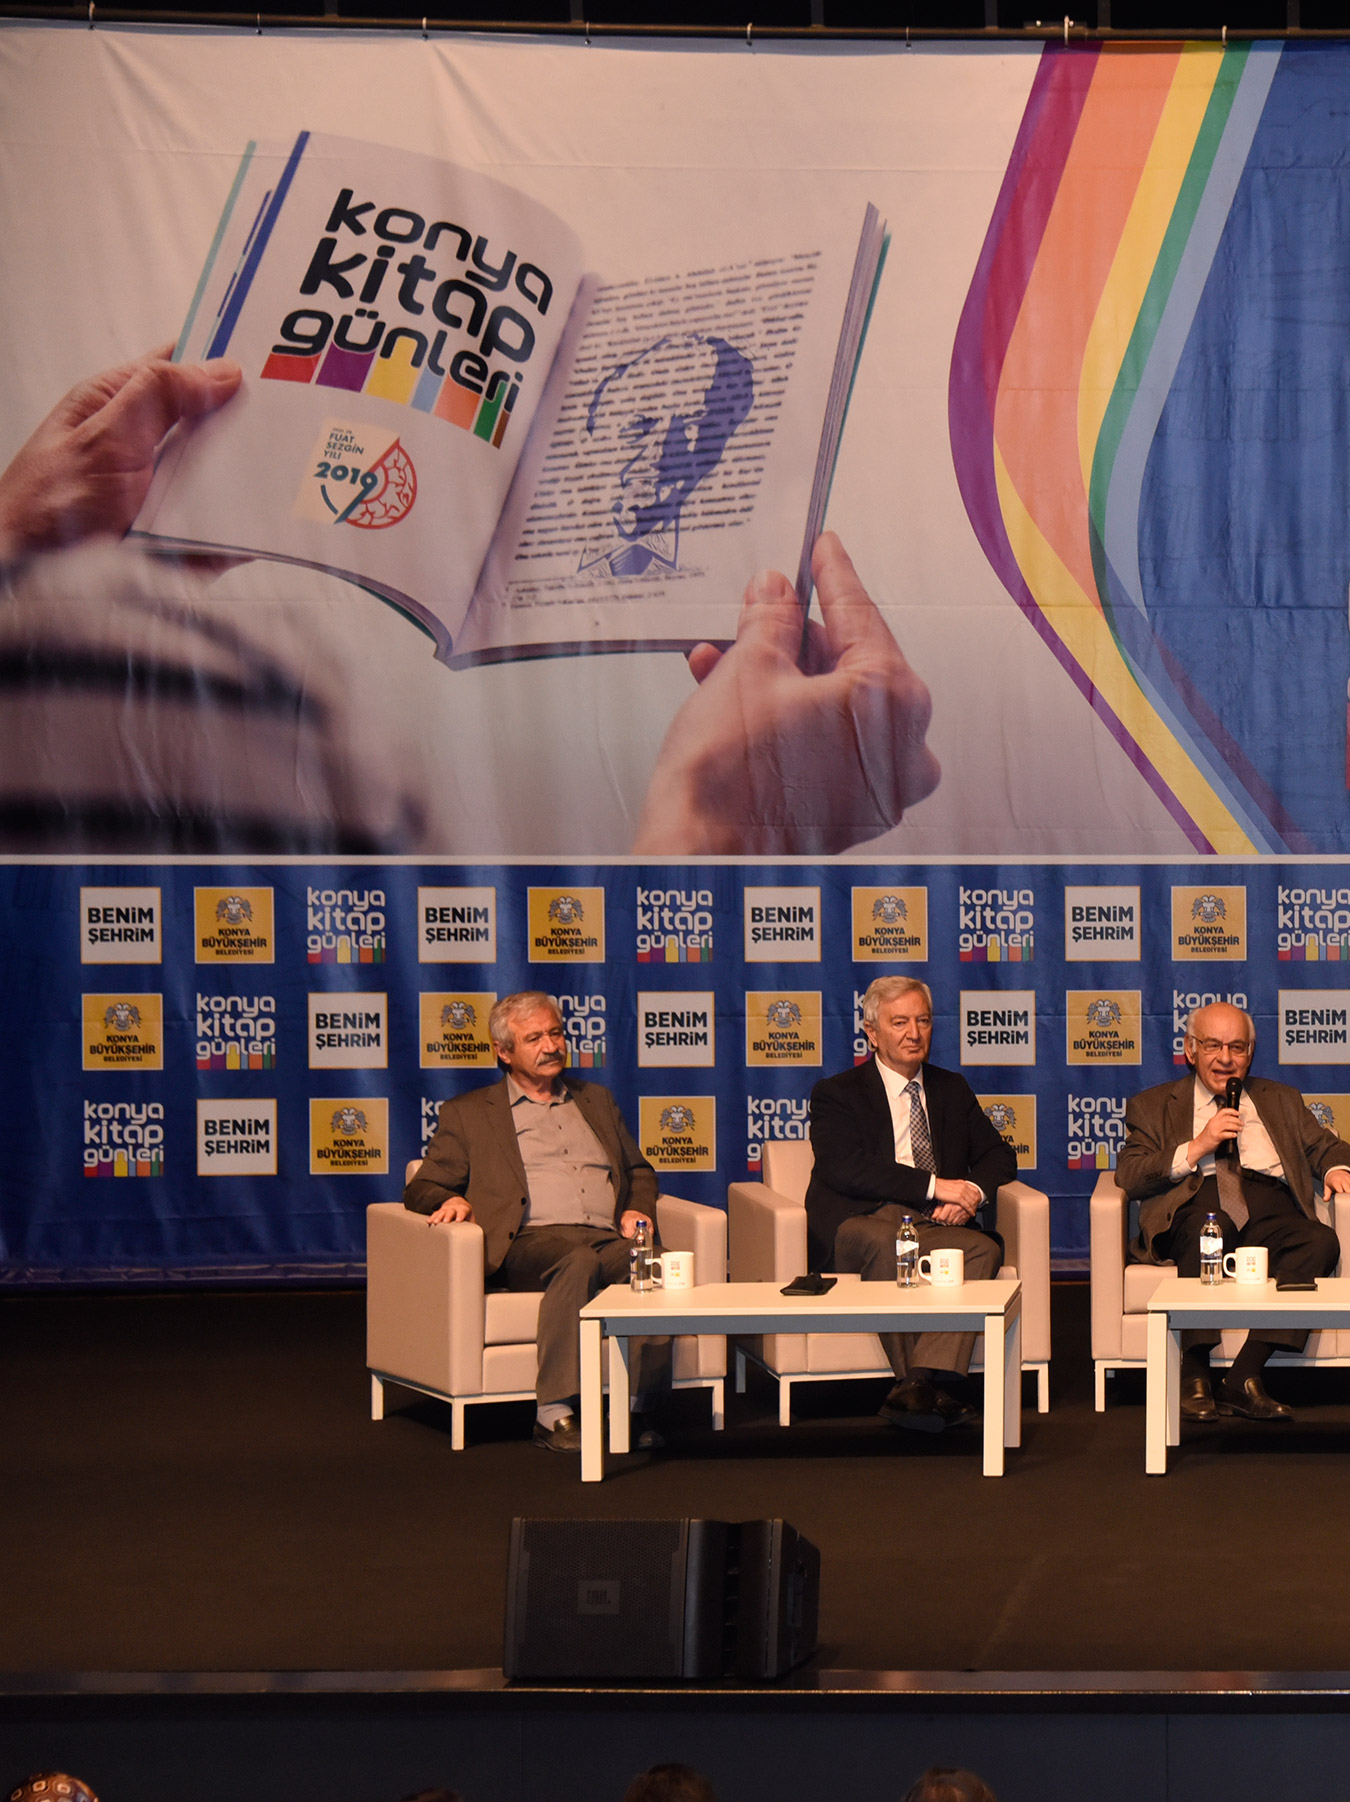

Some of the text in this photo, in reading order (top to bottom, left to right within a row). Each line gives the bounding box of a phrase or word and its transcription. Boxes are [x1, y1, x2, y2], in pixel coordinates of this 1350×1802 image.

[325, 188, 553, 316] konya
[299, 237, 536, 363] kitap
[271, 308, 523, 413] günleri
[329, 433, 355, 443] FUAT
[326, 441, 365, 455] SEZGİN
[323, 450, 342, 460] YILI
[307, 887, 386, 911] konya
[637, 887, 714, 911] konya
[960, 886, 1034, 910] konya
[307, 907, 386, 934] kitap
[637, 907, 714, 934] kitap
[960, 906, 1034, 933] kitap
[218, 927, 250, 937] KONYA
[550, 926, 581, 937] KONYA
[875, 925, 905, 936] KONYA
[1194, 925, 1224, 935] KONYA
[202, 936, 267, 949] BÜYÜKŞEHİR
[307, 932, 386, 954] günleri
[535, 935, 597, 948] BÜYÜKŞEHİR
[637, 932, 714, 954] günleri
[859, 934, 921, 947] BÜYÜKŞEHİR
[960, 931, 1034, 952] günleri
[1179, 933, 1239, 946] BÜYÜKŞEHİR
[196, 993, 276, 1017] konya
[196, 1013, 276, 1040] kitap
[106, 1033, 139, 1043] KONYA
[443, 1031, 474, 1042] KONYA
[769, 1030, 799, 1041] KONYA
[1089, 1029, 1119, 1039] KONYA
[90, 1042, 155, 1055] BÜYÜKŞEHİR
[196, 1038, 276, 1060] günleri
[427, 1041, 490, 1053] BÜYÜKŞEHİR
[753, 1039, 815, 1052] BÜYÜKŞEHİR
[1073, 1037, 1134, 1050] BÜYÜKŞEHİR
[83, 1100, 164, 1124] konya
[748, 1095, 811, 1119] kony
[83, 1120, 164, 1147] kitap
[333, 1138, 365, 1148] KONYA
[662, 1135, 693, 1146] KONYA
[83, 1145, 164, 1166] günleri
[317, 1147, 381, 1160] BÜYÜKŞEHİR
[646, 1144, 708, 1157] BÜYÜKŞEHİR
